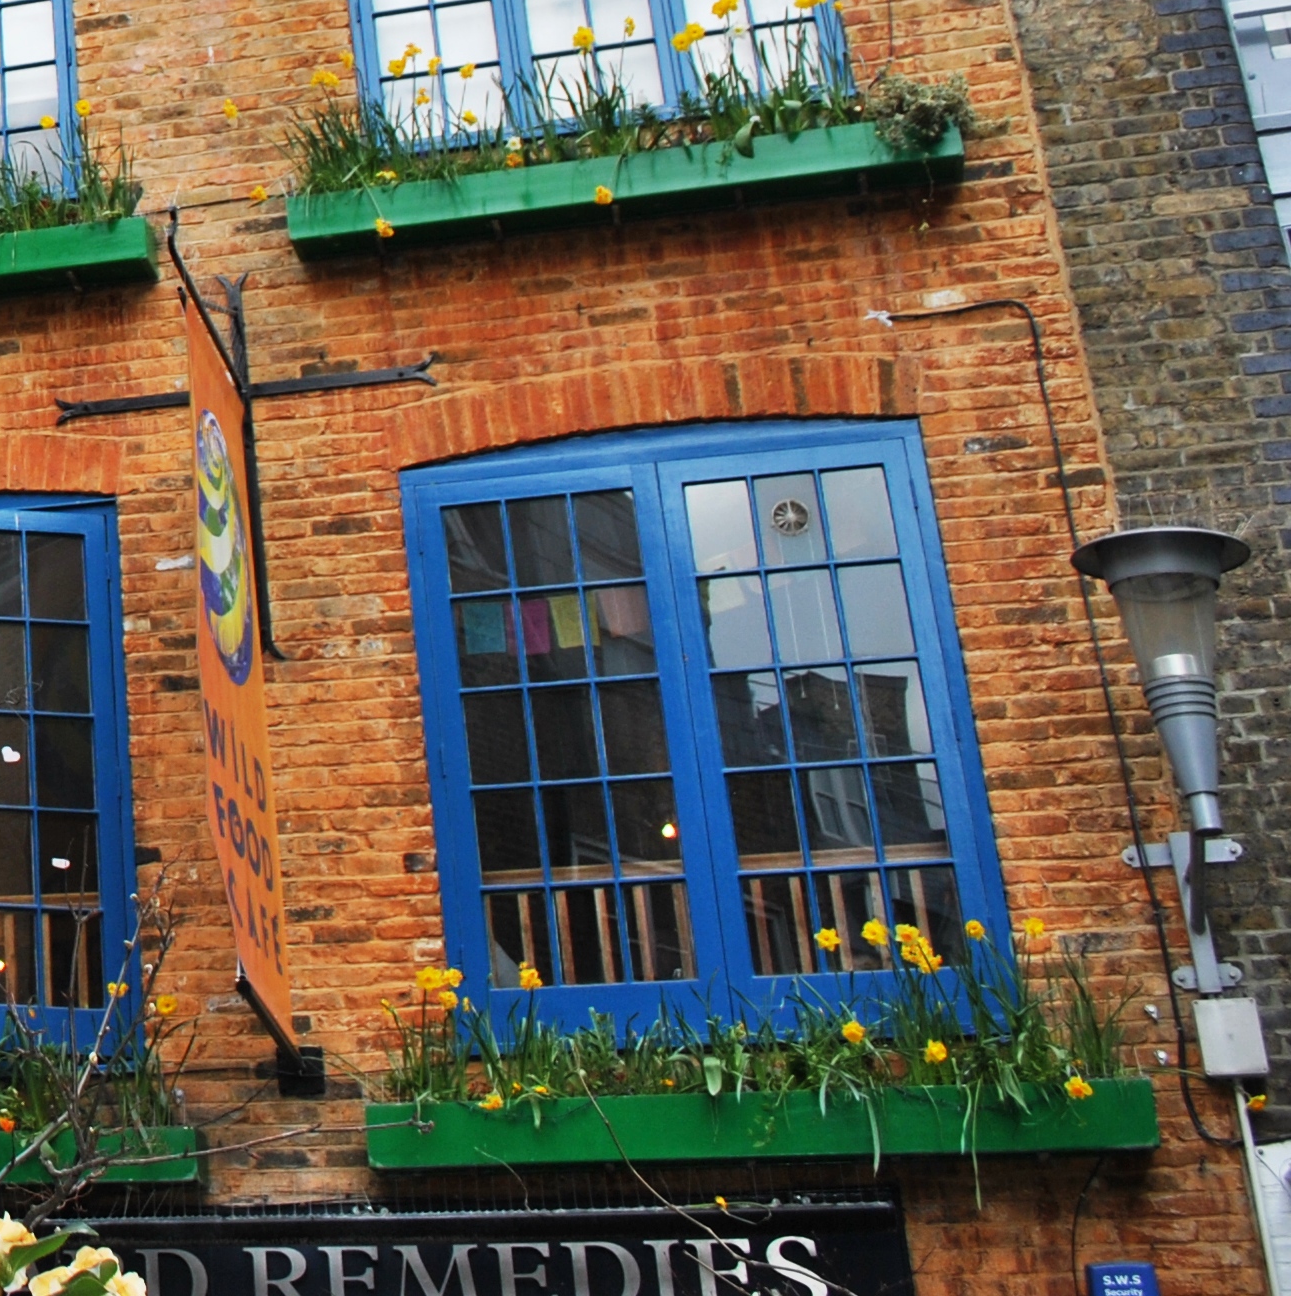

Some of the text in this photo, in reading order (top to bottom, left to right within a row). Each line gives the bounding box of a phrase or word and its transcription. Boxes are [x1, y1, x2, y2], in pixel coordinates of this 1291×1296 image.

[204, 699, 267, 813] WILD
[213, 781, 274, 892] FOOD
[242, 1236, 828, 1296] REMEDIES
[1102, 1274, 1142, 1286] S.W.S
[1104, 1287, 1144, 1296] Security
